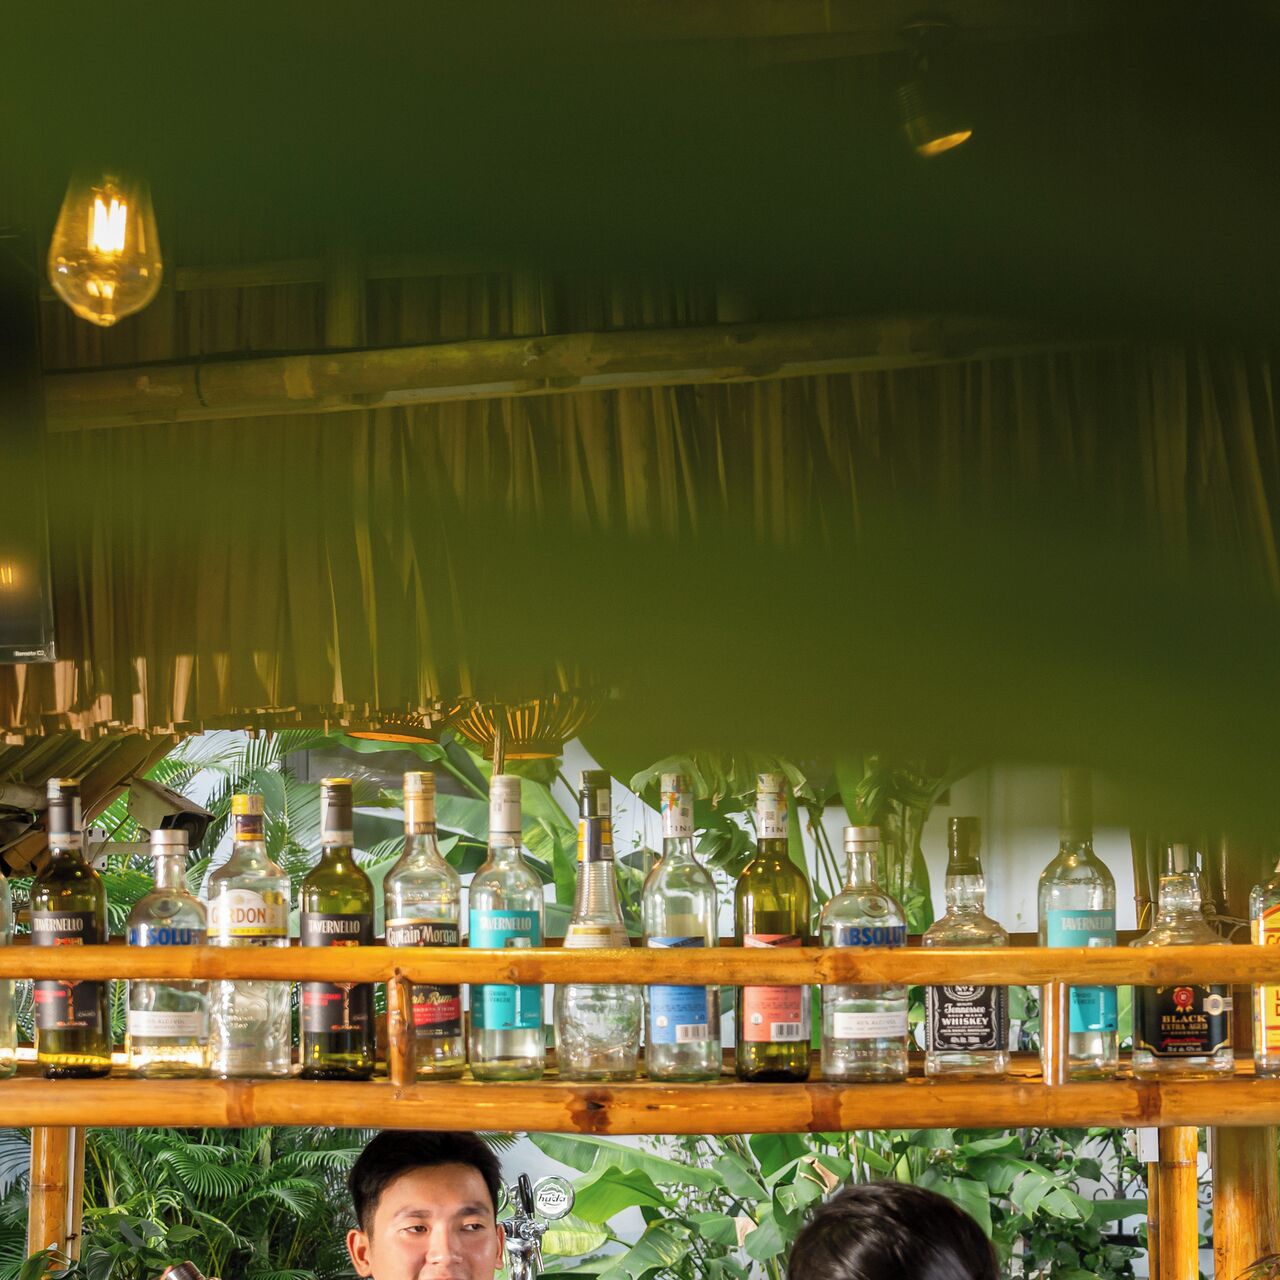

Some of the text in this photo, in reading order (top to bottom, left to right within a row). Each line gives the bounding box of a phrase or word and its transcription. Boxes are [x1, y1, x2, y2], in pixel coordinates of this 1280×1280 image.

[34, 917, 84, 932] TAVERNELLO
[308, 919, 361, 934] TAVERNELLO
[129, 927, 199, 946] ASOLU
[387, 927, 421, 948] Captain
[839, 925, 907, 947] ABSOLUT
[944, 1003, 986, 1014] Tennessee
[941, 1017, 989, 1026] WHISKEY
[1161, 1015, 1207, 1023] BLACK
